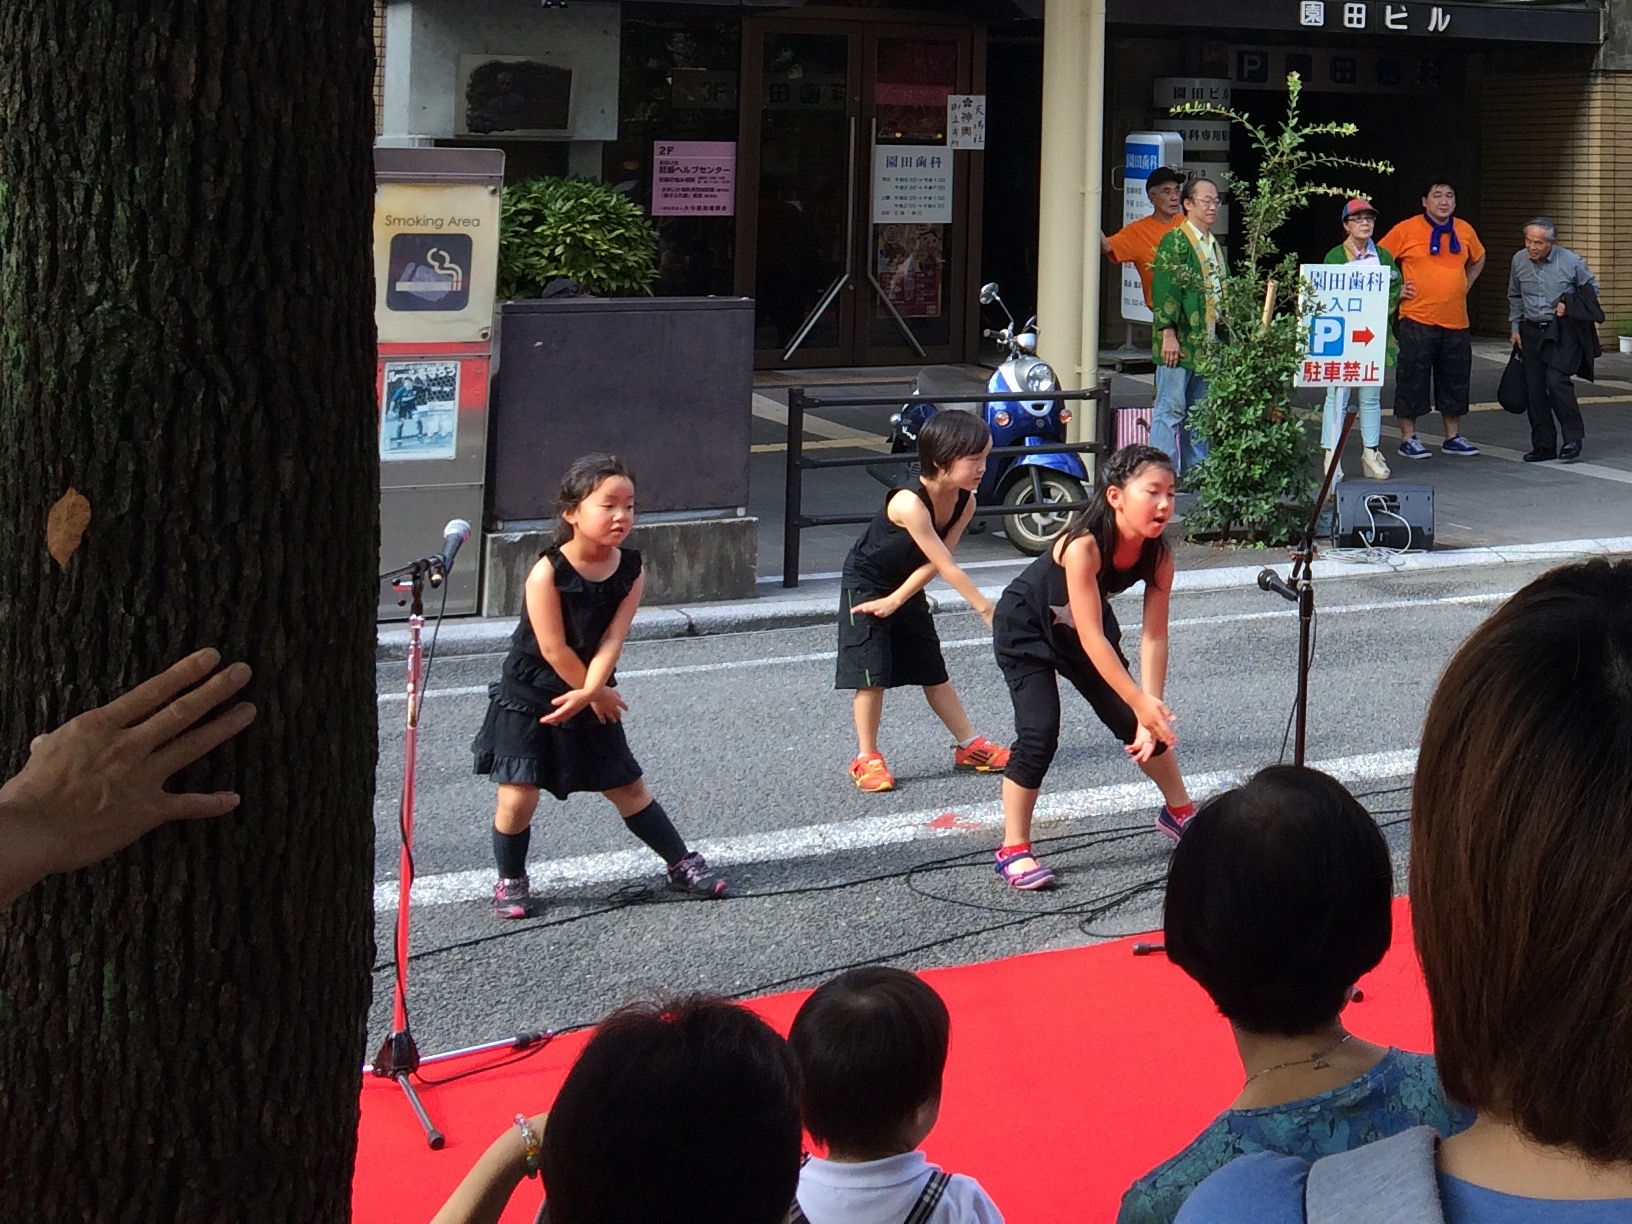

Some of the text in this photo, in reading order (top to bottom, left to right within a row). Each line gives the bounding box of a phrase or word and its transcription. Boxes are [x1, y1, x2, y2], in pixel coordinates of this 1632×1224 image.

[1300, 1, 1451, 32] 園田ビル
[659, 146, 675, 156] 2F
[886, 155, 943, 169] 園田歯科
[384, 214, 481, 230] Smoking Area
[1309, 271, 1384, 292] 園田歯科
[1328, 297, 1363, 313] 入口
[1313, 318, 1342, 354] P
[1302, 360, 1380, 383] 駐車禁止
